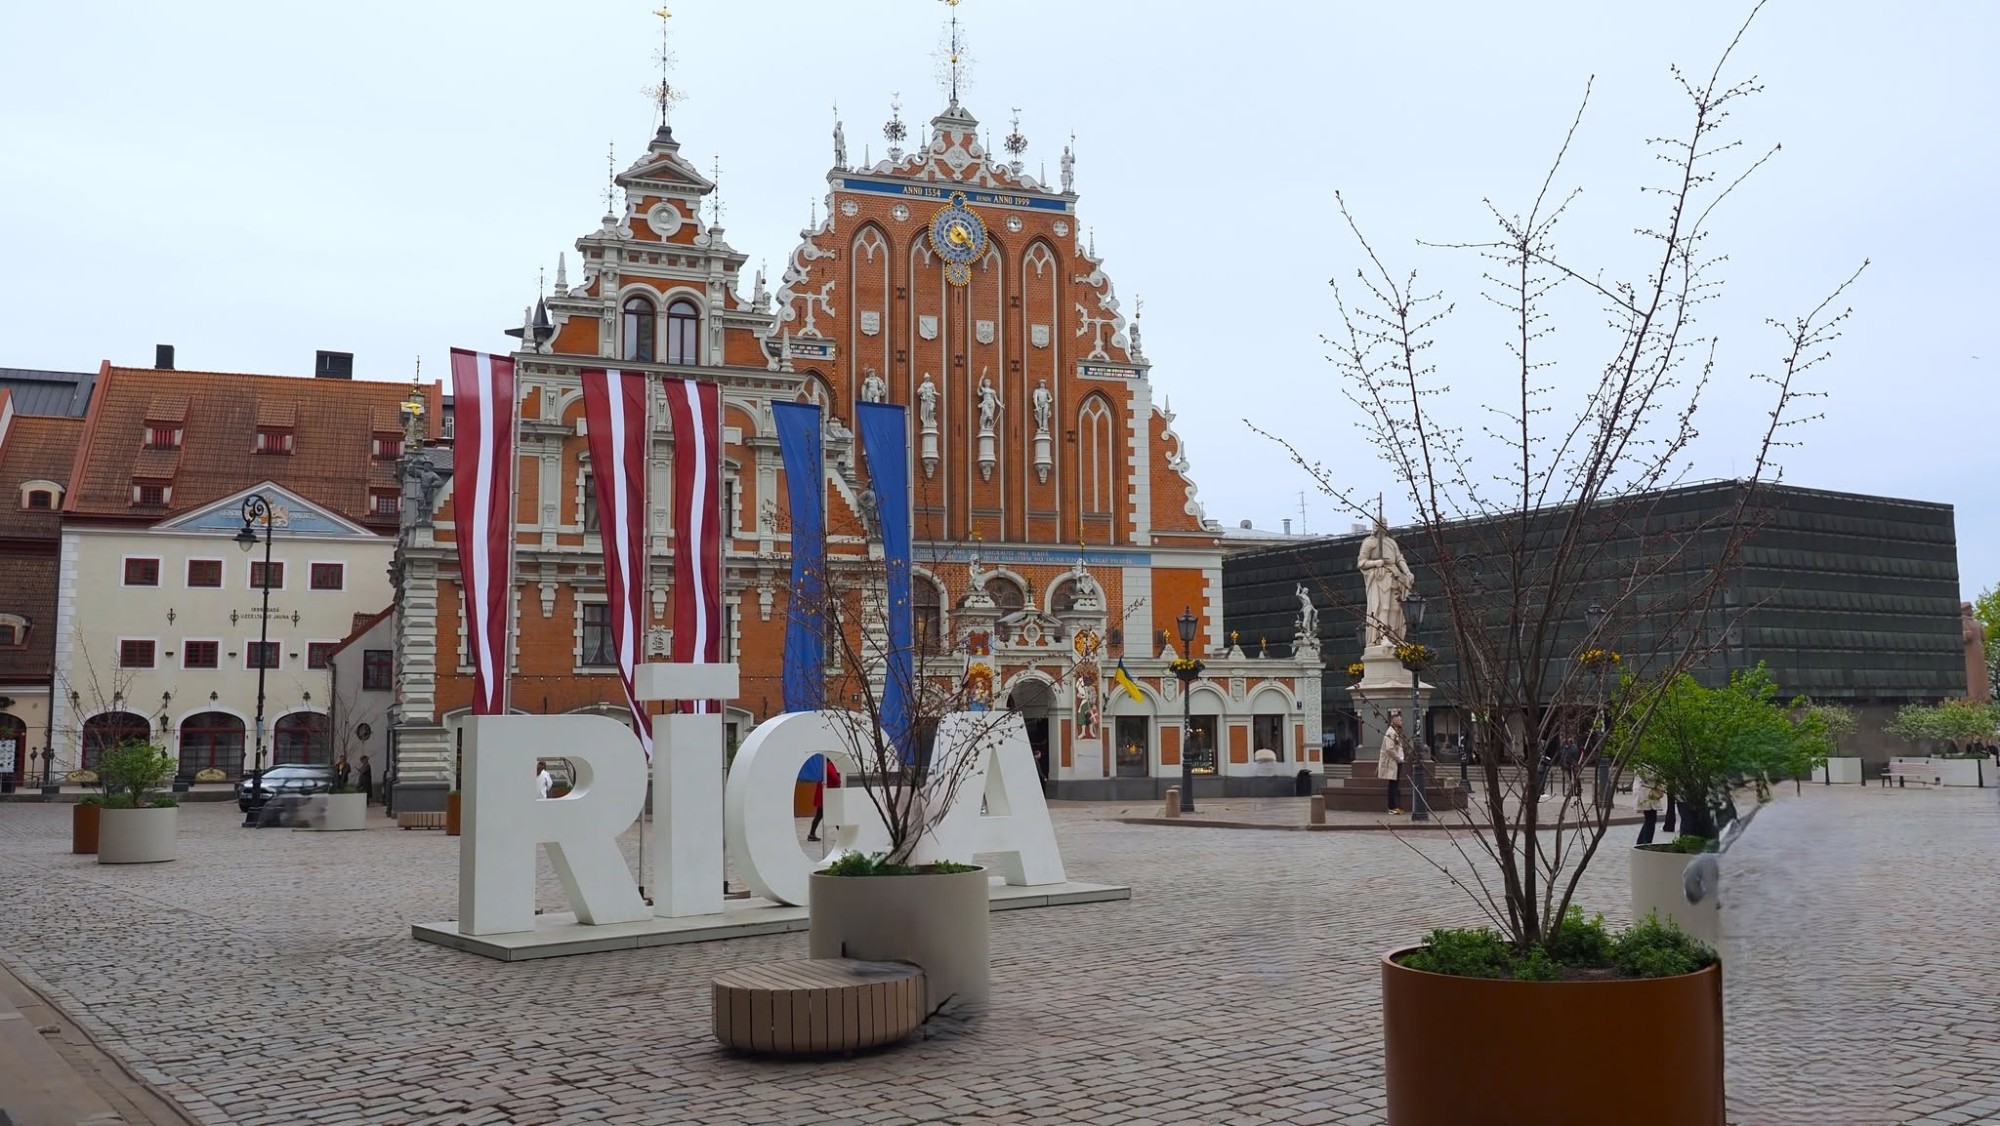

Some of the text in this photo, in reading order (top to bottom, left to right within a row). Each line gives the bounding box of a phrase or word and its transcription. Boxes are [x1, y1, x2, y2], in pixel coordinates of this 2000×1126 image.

[902, 185, 923, 195] ANNO
[993, 195, 1013, 205] ANNO
[1014, 196, 1030, 206] 1999
